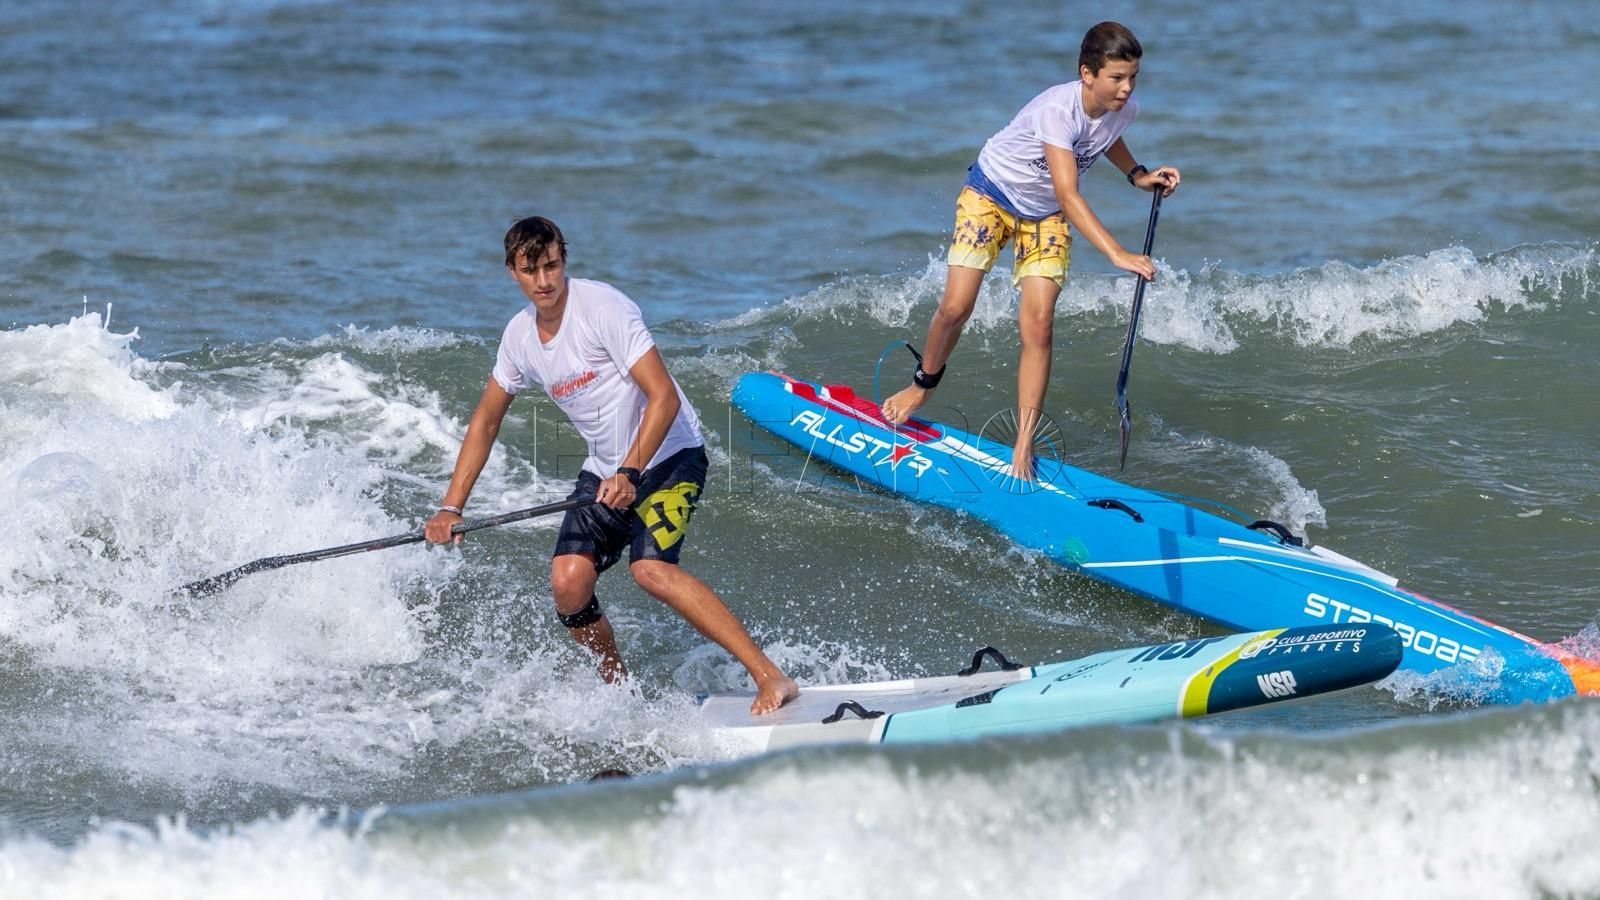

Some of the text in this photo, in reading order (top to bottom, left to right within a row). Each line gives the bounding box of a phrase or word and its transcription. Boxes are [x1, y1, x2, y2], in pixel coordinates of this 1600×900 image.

[1278, 629, 1367, 646] CLUB DEPORTIVO
[1268, 641, 1361, 656] PARRES
[1256, 670, 1297, 699] NSP
